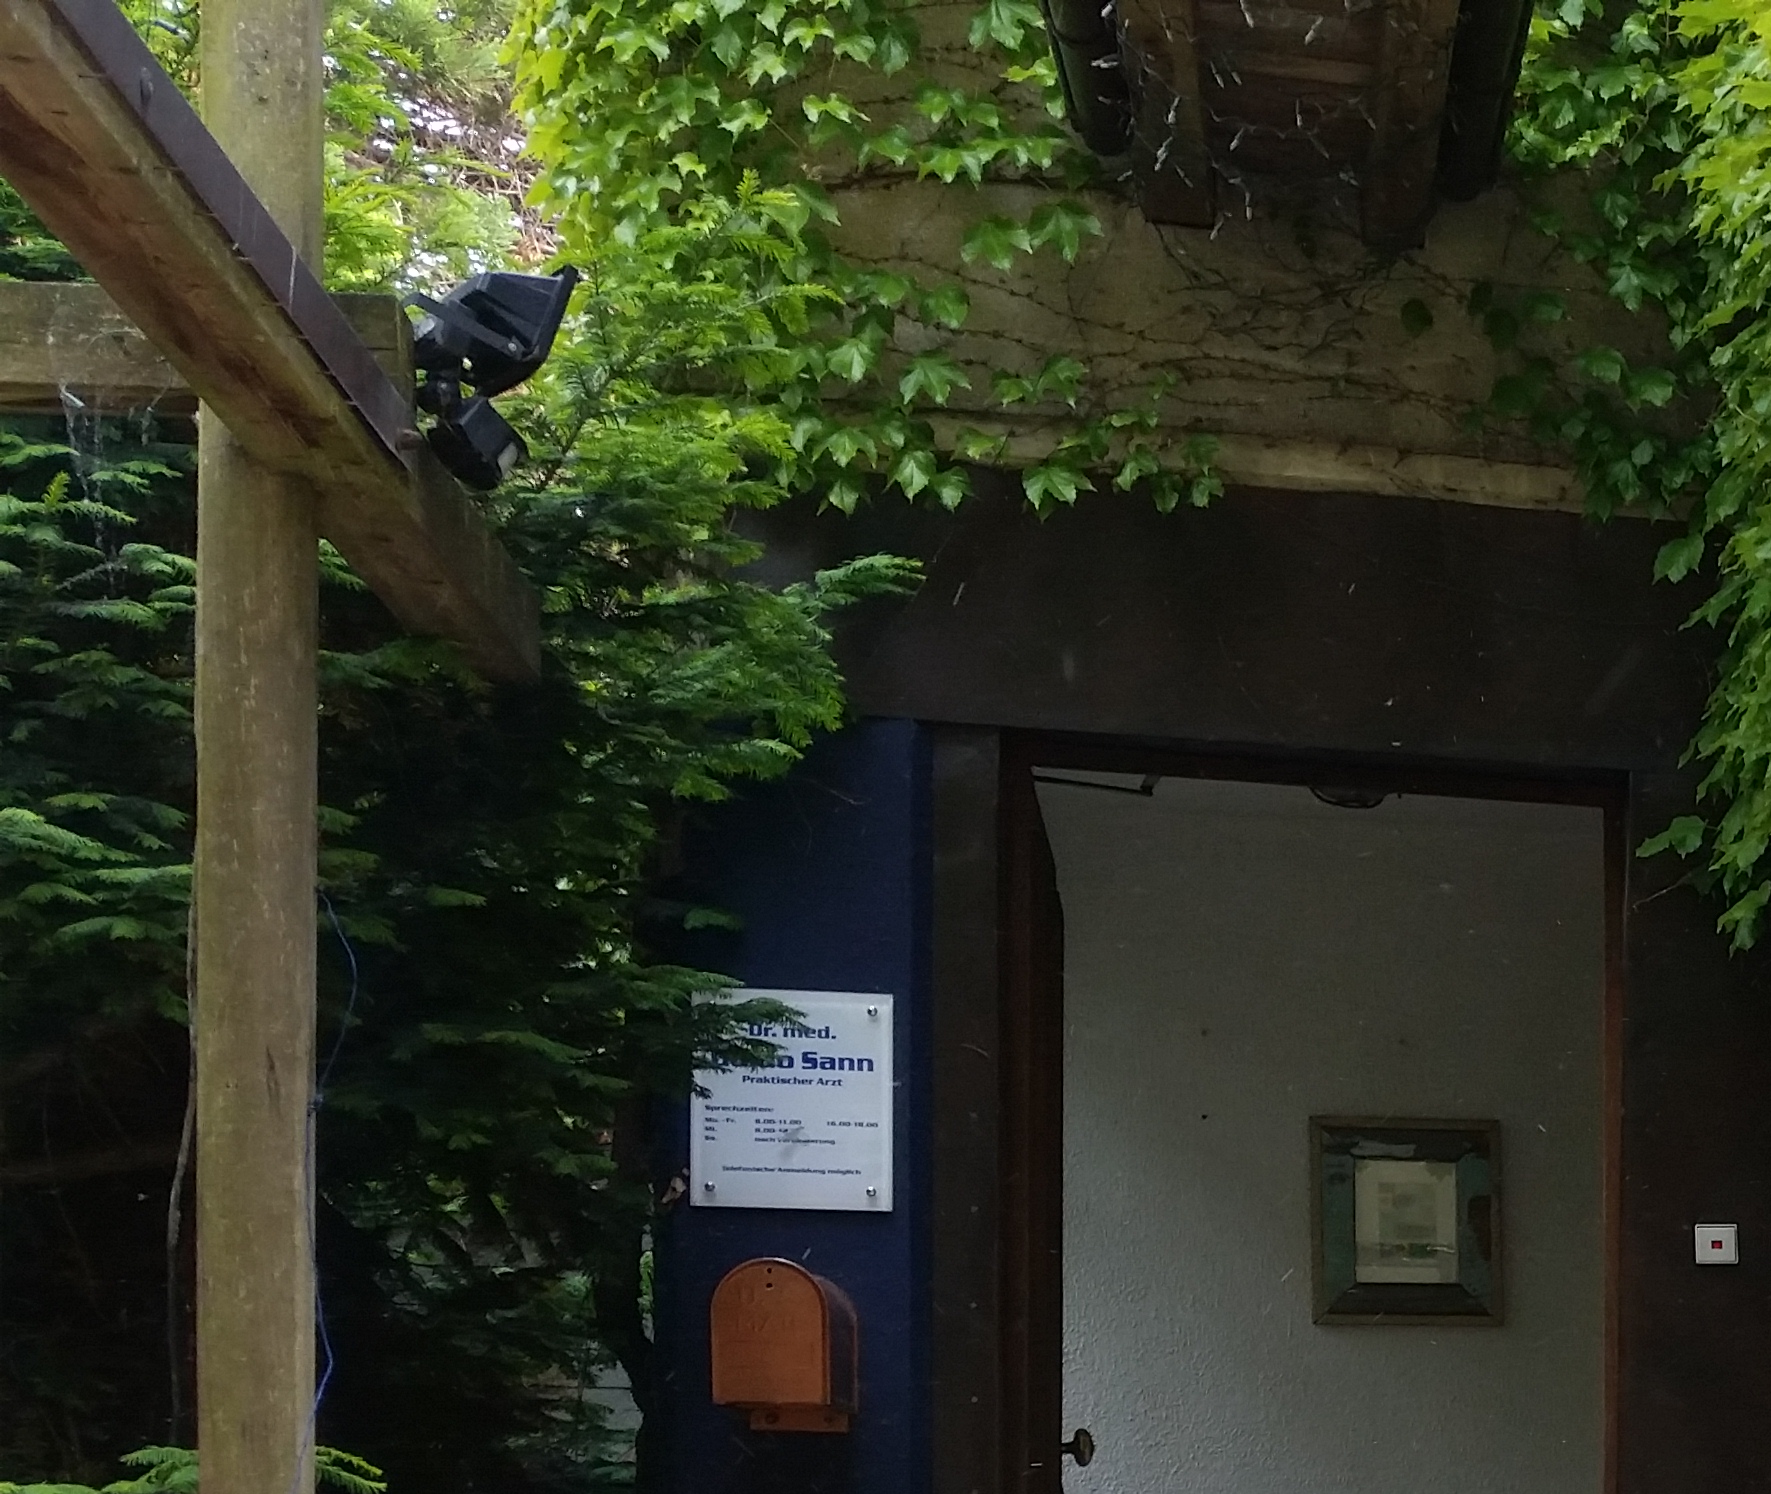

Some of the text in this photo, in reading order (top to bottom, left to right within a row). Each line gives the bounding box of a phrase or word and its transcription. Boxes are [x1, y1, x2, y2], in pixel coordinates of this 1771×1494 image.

[749, 1024, 837, 1040] Dr. med.
[801, 1051, 875, 1072] Sann
[742, 1075, 843, 1087] Praktischer Arzt
